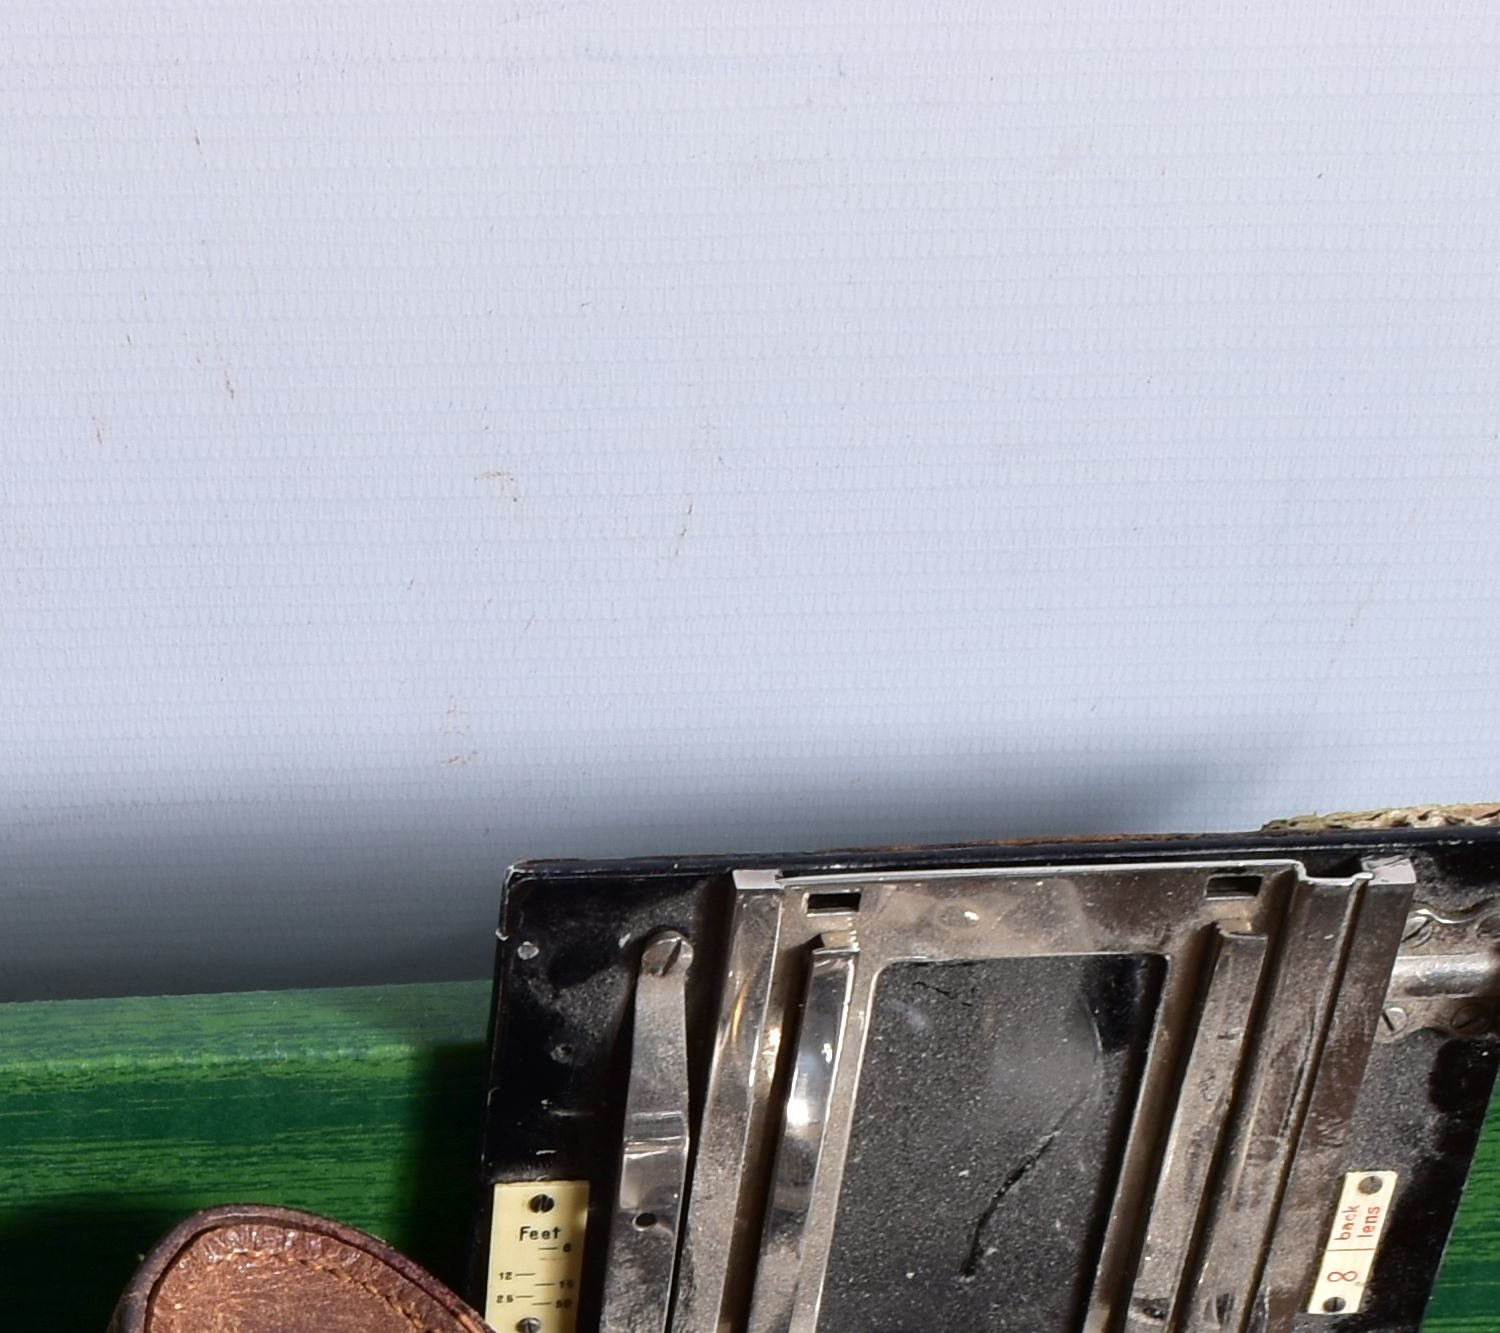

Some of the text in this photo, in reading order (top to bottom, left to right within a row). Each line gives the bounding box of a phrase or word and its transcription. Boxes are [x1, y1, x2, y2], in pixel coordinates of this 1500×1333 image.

[519, 1227, 561, 1241] Feet
[1333, 1205, 1361, 1240] back
[1356, 1206, 1381, 1238] lens
